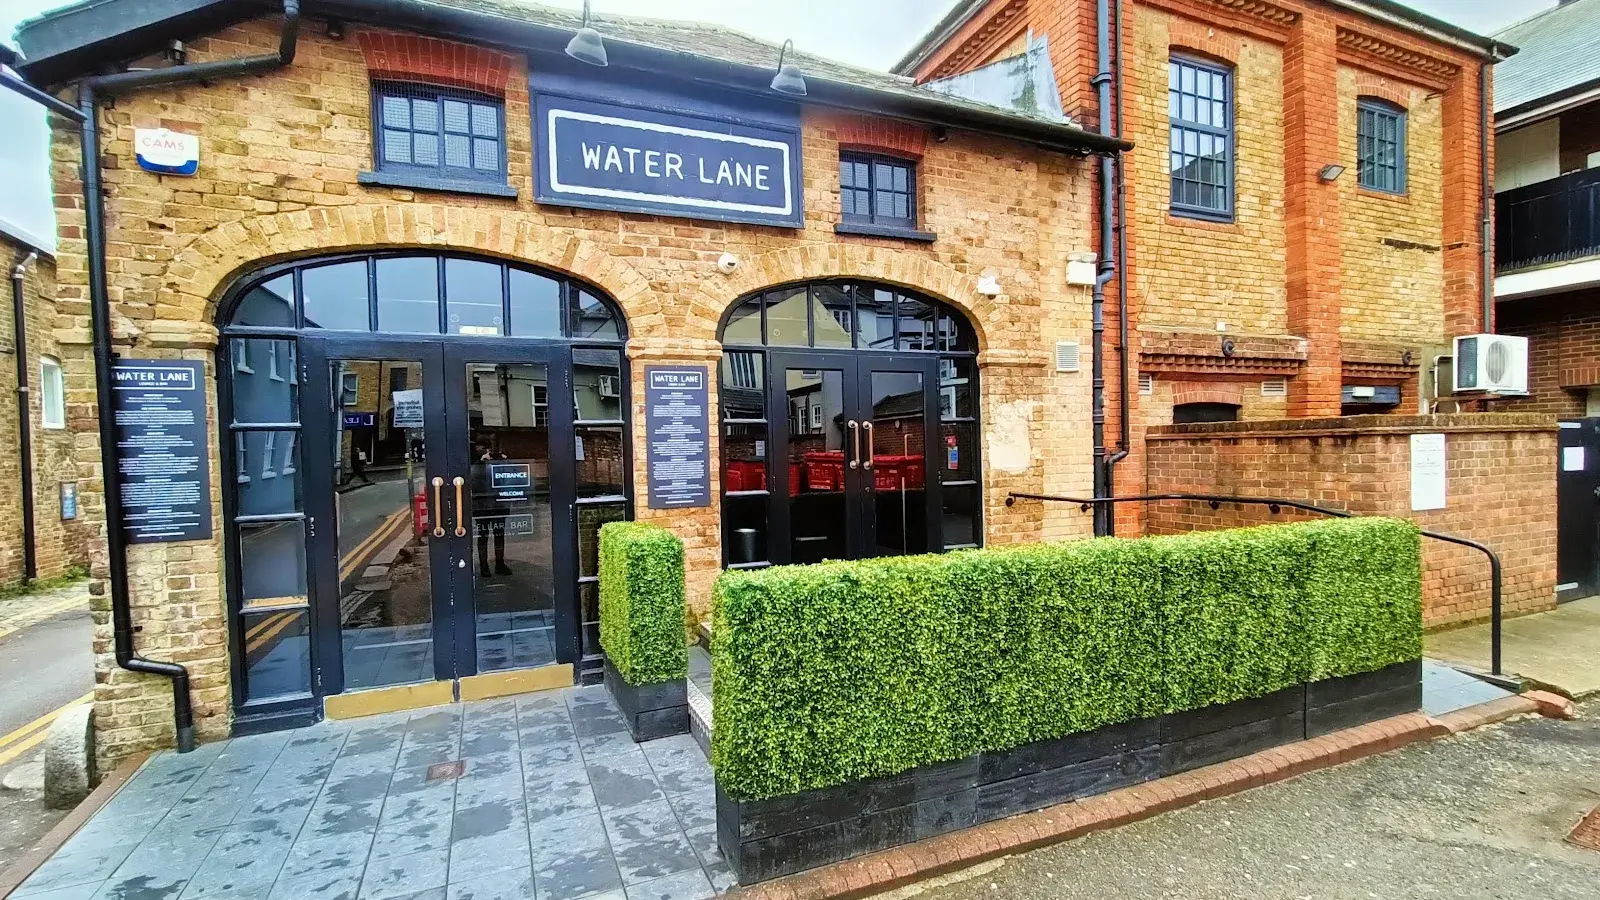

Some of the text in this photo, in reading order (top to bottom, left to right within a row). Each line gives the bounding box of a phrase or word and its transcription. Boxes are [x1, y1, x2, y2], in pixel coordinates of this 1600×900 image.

[142, 137, 184, 151] CAMS
[581, 142, 770, 191] WATER LANE
[116, 372, 189, 381] WATER LANE
[654, 375, 699, 383] WATER LANE
[510, 520, 528, 530] BAR
